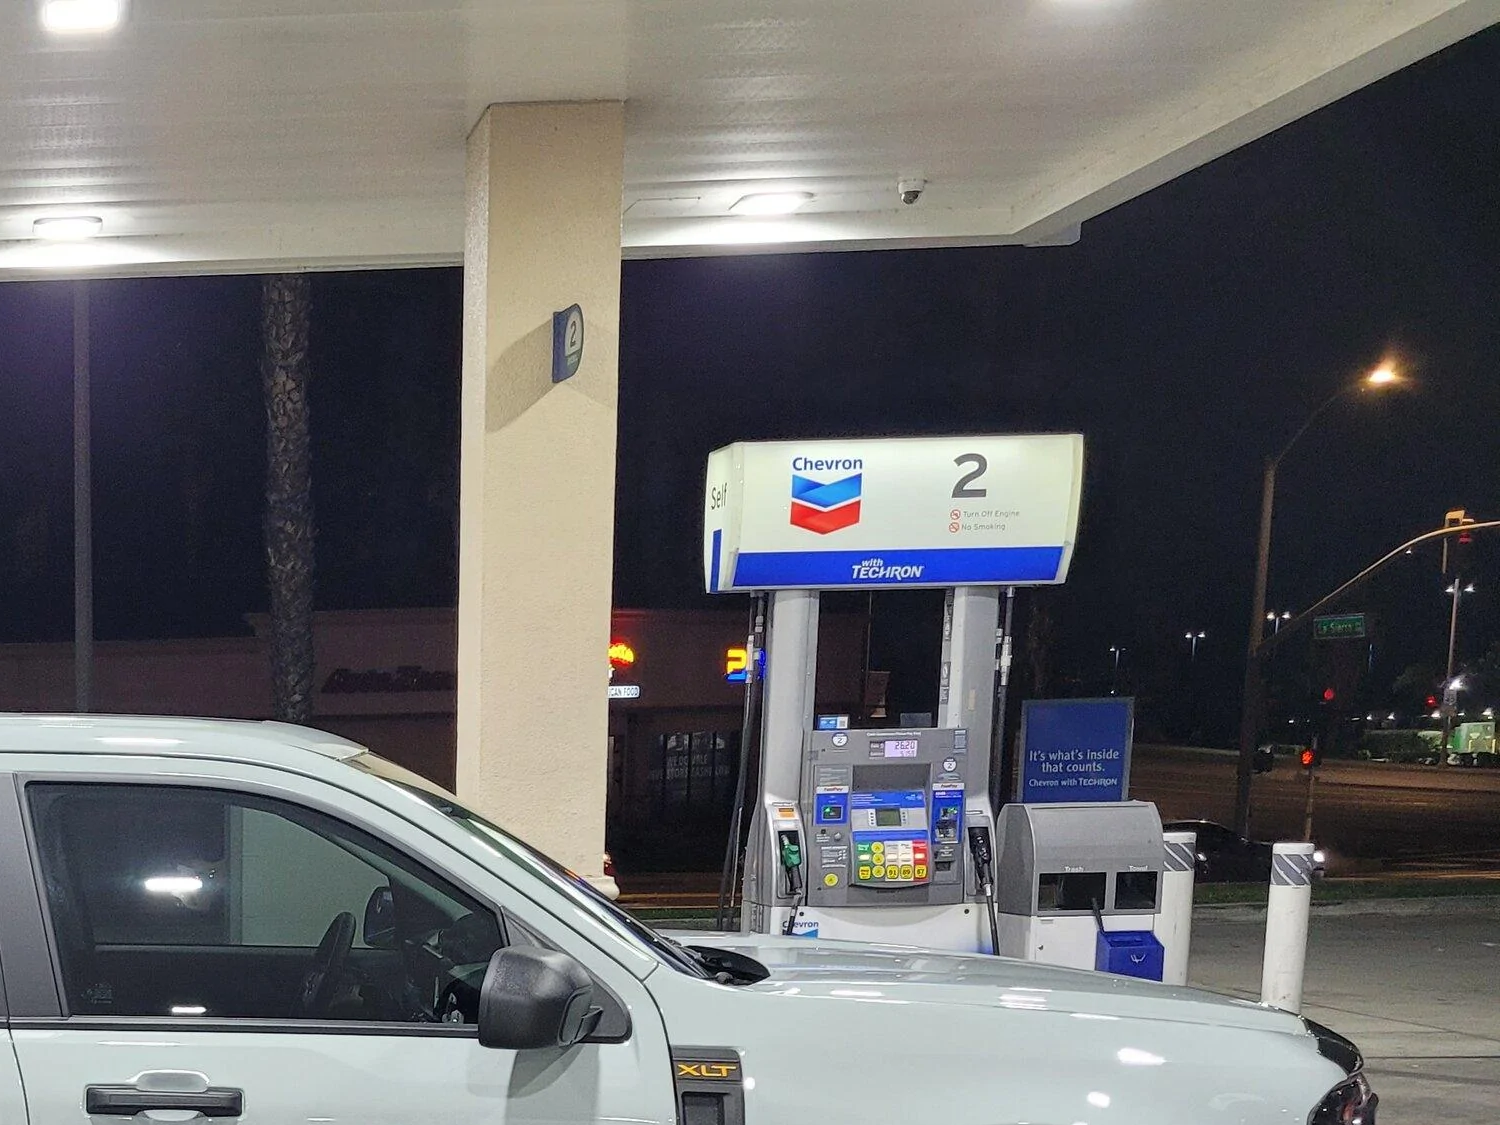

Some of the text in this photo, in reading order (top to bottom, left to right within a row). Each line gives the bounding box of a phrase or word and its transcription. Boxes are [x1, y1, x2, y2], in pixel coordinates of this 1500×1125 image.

[569, 320, 577, 348] 2
[792, 457, 863, 471] Chevron
[951, 453, 988, 498] 2
[710, 482, 727, 510] Self
[994, 510, 1020, 518] Engine
[973, 523, 1005, 531] Smoking
[861, 558, 883, 566] with
[852, 565, 925, 580] TECHRON
[623, 687, 638, 696] FOOD
[1029, 749, 1120, 761] It's what's inside
[1041, 762, 1105, 773] that counts.
[1029, 778, 1118, 787] Chevron with TECHRON
[782, 920, 819, 929] Cevron
[677, 1064, 737, 1077] XLT
